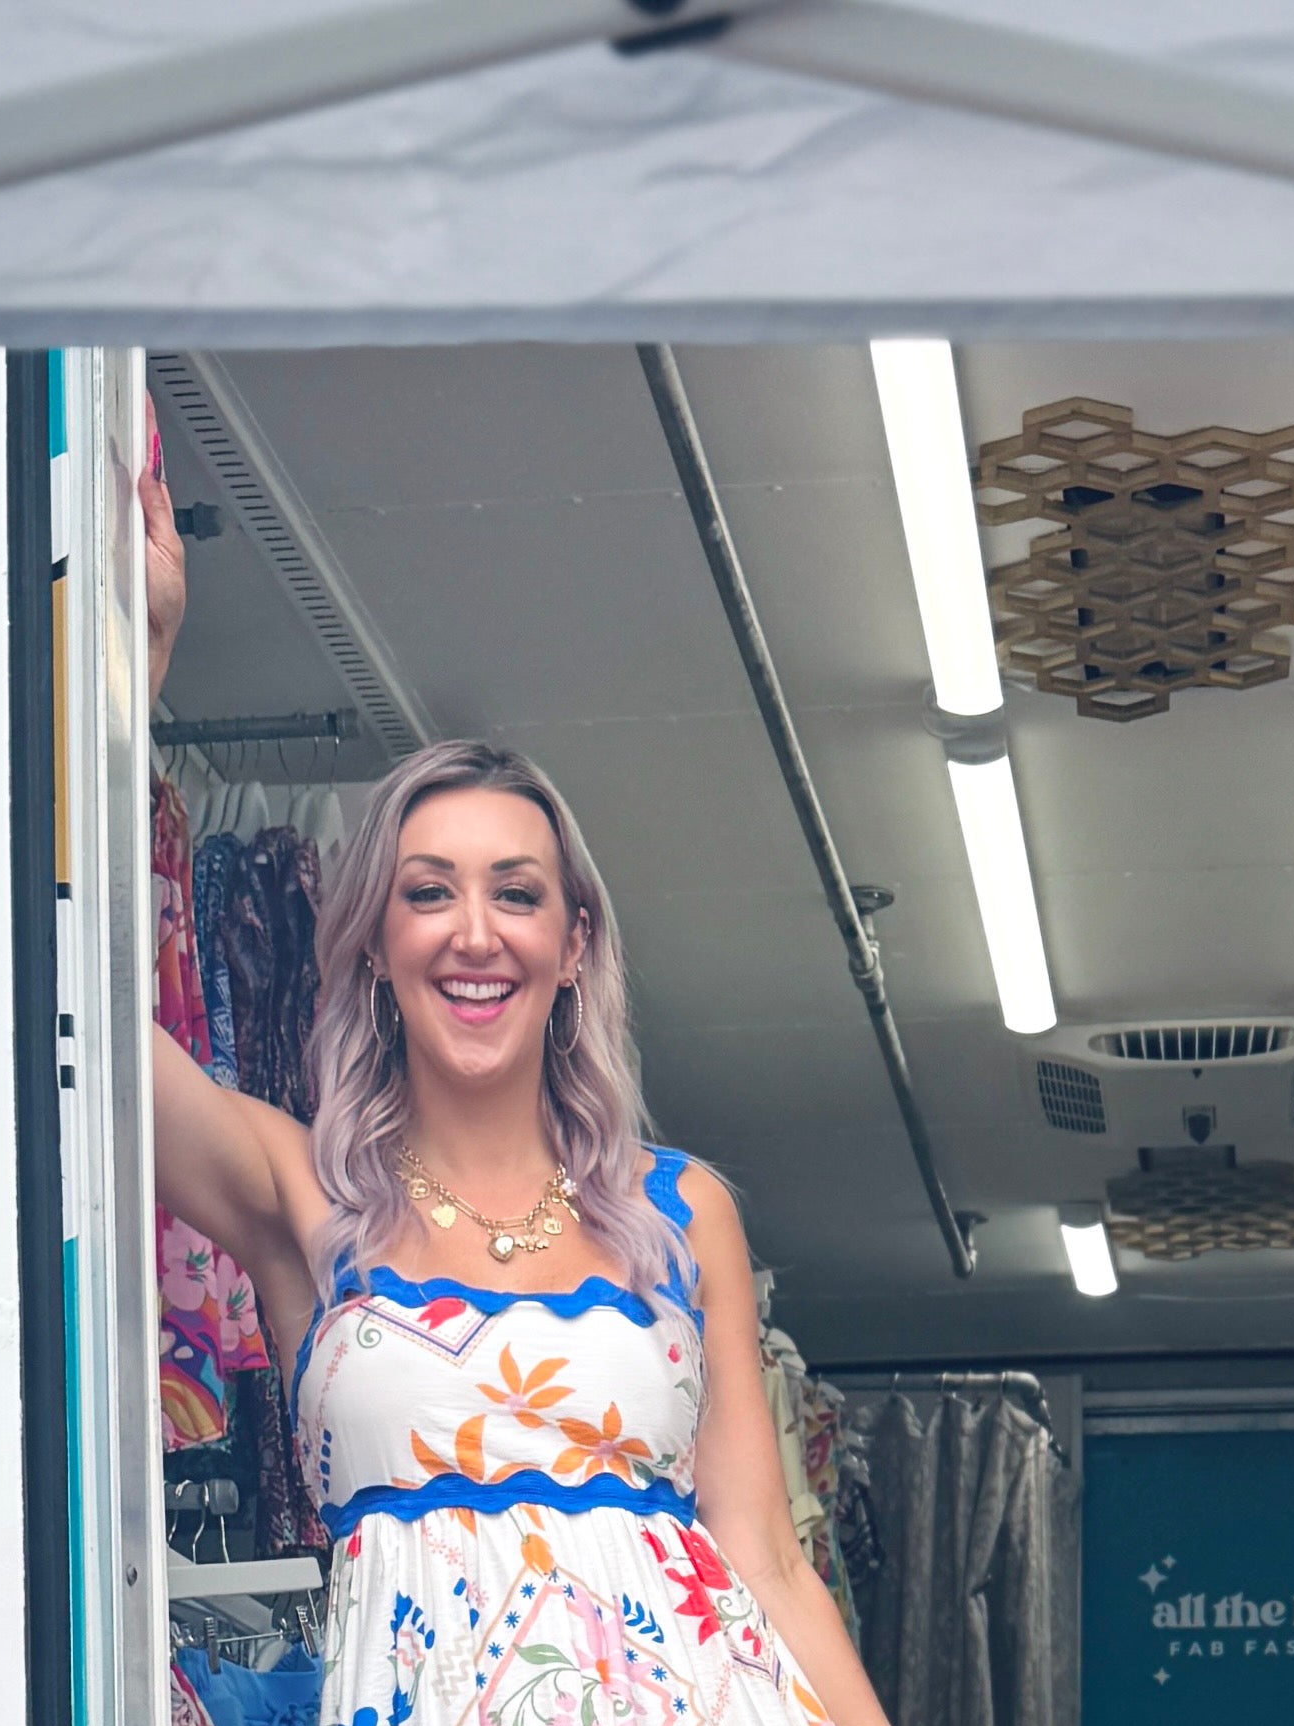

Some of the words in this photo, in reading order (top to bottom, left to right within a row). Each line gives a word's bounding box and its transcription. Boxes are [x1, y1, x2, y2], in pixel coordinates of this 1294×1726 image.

[1153, 1593, 1205, 1628] all
[1213, 1592, 1286, 1627] the
[1169, 1641, 1224, 1657] FAB
